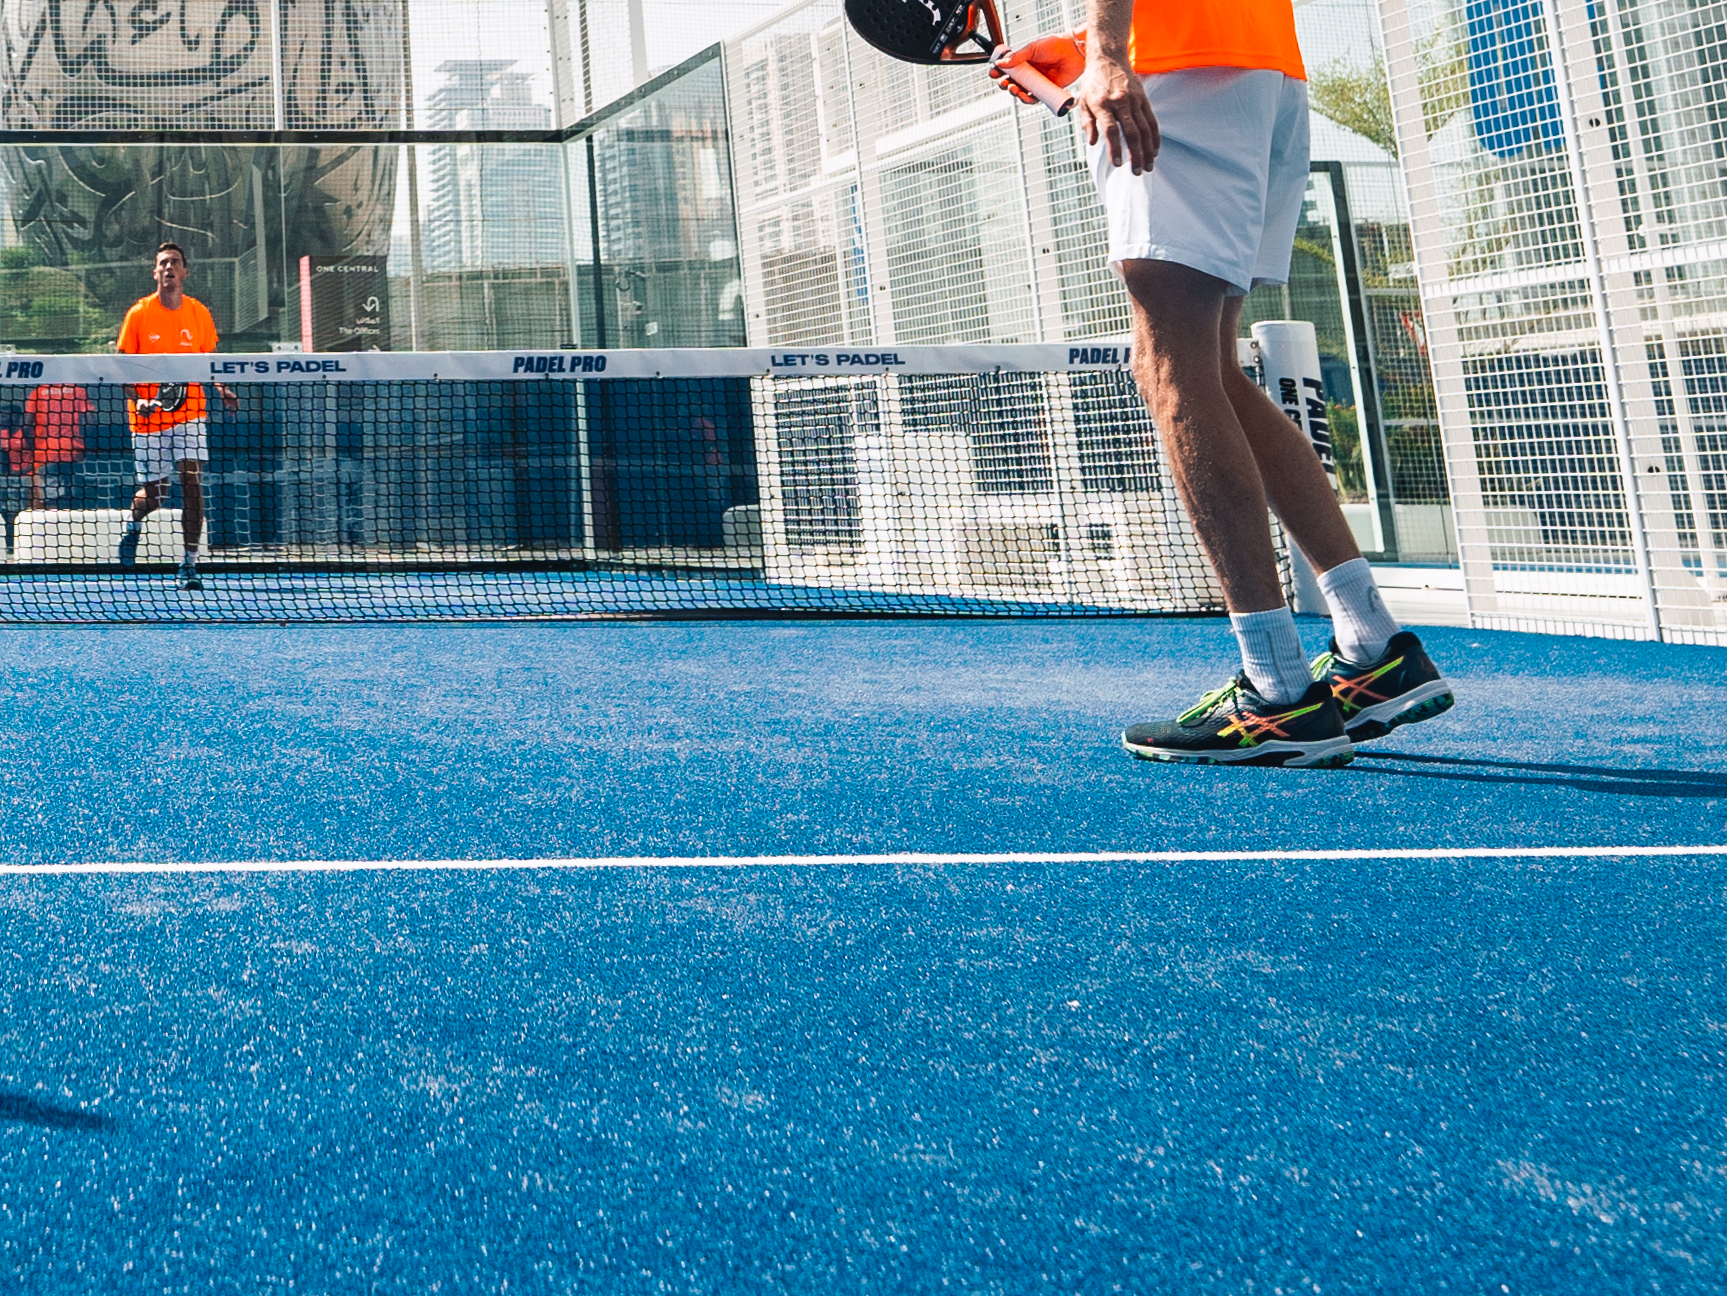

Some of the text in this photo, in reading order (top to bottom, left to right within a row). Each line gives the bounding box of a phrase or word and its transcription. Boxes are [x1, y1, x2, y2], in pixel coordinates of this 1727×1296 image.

[315, 265, 379, 273] ONE CENTRAL
[512, 354, 607, 374] PADEL PRO
[770, 353, 906, 367] LET'S PADEL
[1068, 347, 1120, 365] PADEL
[6, 360, 44, 379] PRO
[210, 360, 347, 374] LET'S PADEL
[1278, 377, 1300, 406] ONE
